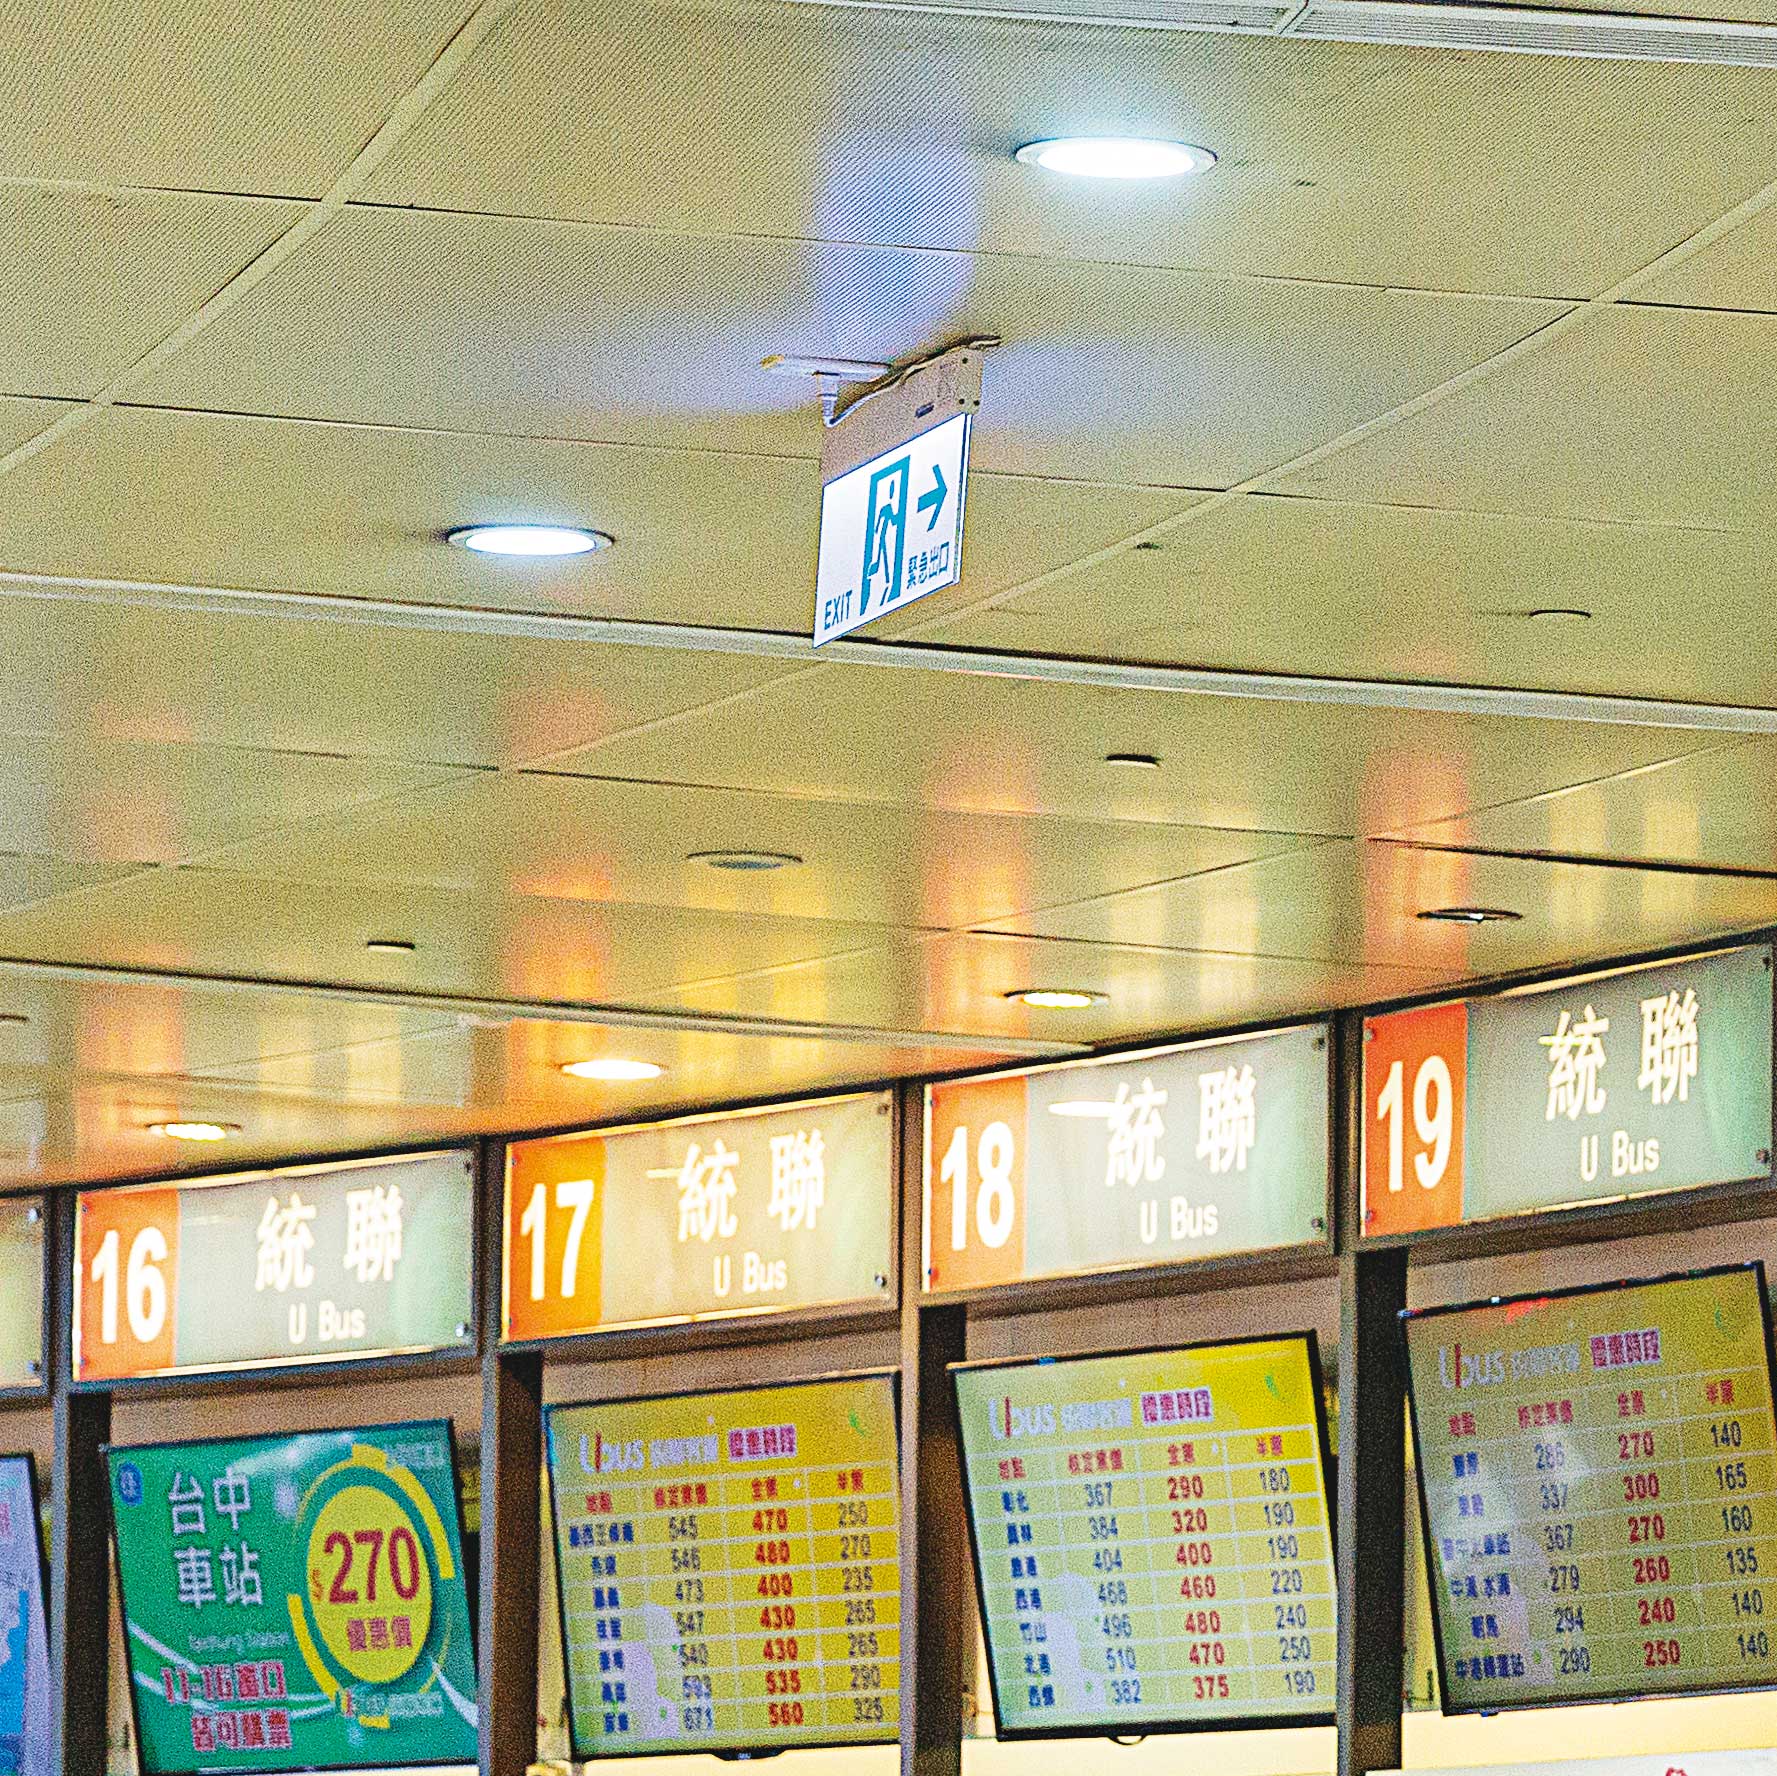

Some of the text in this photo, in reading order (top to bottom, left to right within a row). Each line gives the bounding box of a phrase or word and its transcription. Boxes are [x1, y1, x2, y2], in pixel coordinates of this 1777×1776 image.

[907, 541, 949, 588] 緊急出口
[824, 590, 852, 630] EXIT
[1539, 988, 1699, 1122] 統聯
[1106, 1063, 1257, 1186] 統聯
[1376, 1053, 1454, 1192] 19
[1579, 1131, 1658, 1183] U Bus
[677, 1127, 825, 1245] 統聯
[940, 1119, 1016, 1251] 18
[255, 1184, 402, 1294] 統聯
[520, 1179, 596, 1301] 17
[1140, 1200, 1219, 1243] U Bus
[91, 1225, 167, 1343] 16
[714, 1252, 786, 1296] U Bus
[289, 1299, 366, 1343] U Bus
[1618, 1421, 1741, 1460] 270 140
[168, 1466, 251, 1535] 台中
[1167, 1475, 1203, 1500] 290
[1624, 1473, 1659, 1501] 300
[753, 1509, 788, 1531] 470
[1172, 1501, 1294, 1533] 320 190
[1628, 1514, 1664, 1543] 270
[1176, 1534, 1298, 1566] 400 190
[177, 1541, 262, 1608] 車站
[757, 1574, 793, 1596] 400
[1181, 1575, 1216, 1598] 460
[760, 1606, 795, 1629] 430
[1275, 1604, 1306, 1629] 240
[1638, 1597, 1675, 1625] 240
[763, 1638, 798, 1661] 430
[1189, 1636, 1310, 1665] 470 250
[1644, 1640, 1680, 1667] 250
[1194, 1675, 1229, 1699] 375
